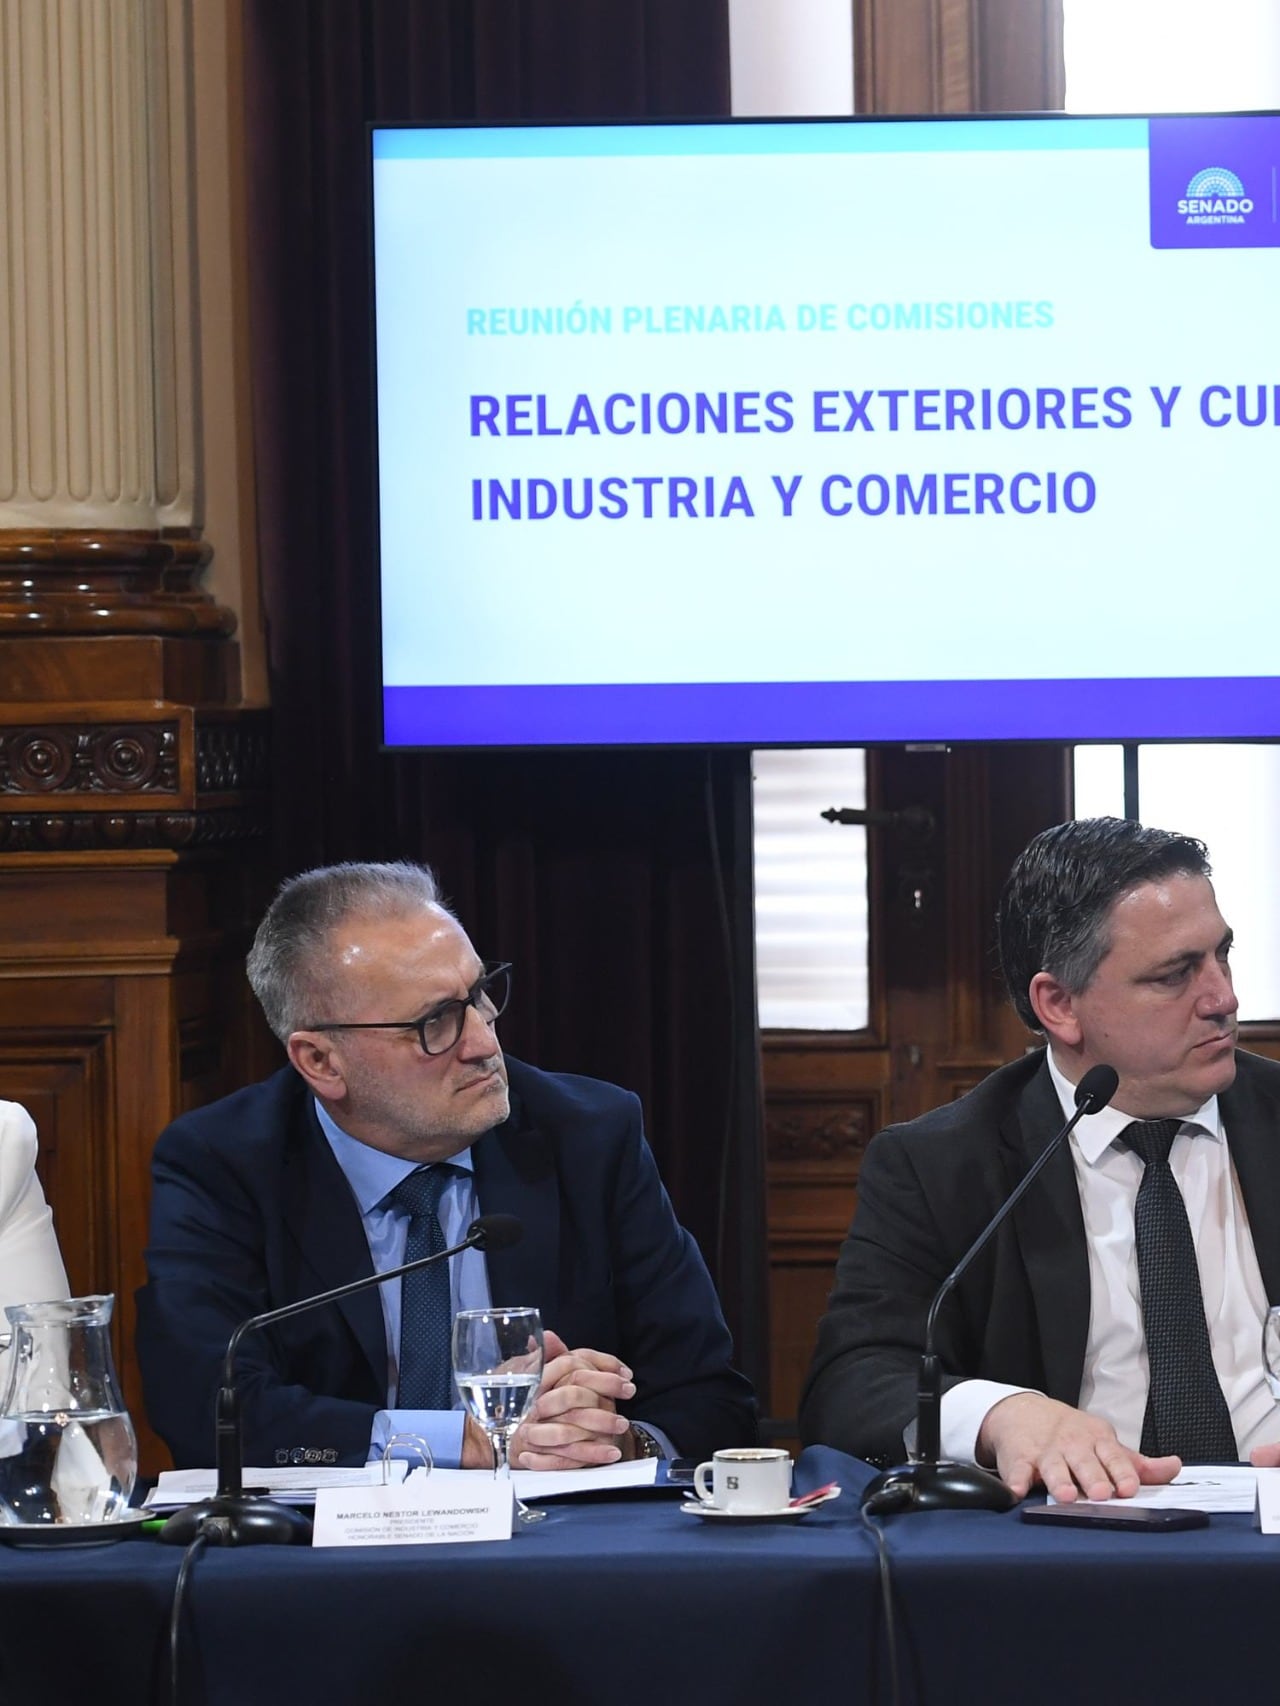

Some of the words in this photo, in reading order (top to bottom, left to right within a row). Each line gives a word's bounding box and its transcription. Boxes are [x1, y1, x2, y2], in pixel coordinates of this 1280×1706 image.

[1177, 198, 1254, 215] SENADO
[1186, 215, 1246, 225] ARGENTINA
[466, 299, 613, 337] REUNIÓN
[622, 303, 787, 334] PLENARIA
[796, 302, 838, 332] DE
[846, 300, 1055, 333] COMISIONES
[469, 390, 794, 437] RELACIONES
[813, 385, 1133, 433] EXTERIORES
[1149, 385, 1182, 429] Y
[471, 475, 756, 521] INDUSTRIA
[770, 474, 803, 518] Y
[820, 470, 1098, 518] COMERCIO
[336, 1511, 381, 1519] MARCELO
[383, 1510, 419, 1518] NESTOR
[422, 1507, 489, 1517] LEWANDOWSKI
